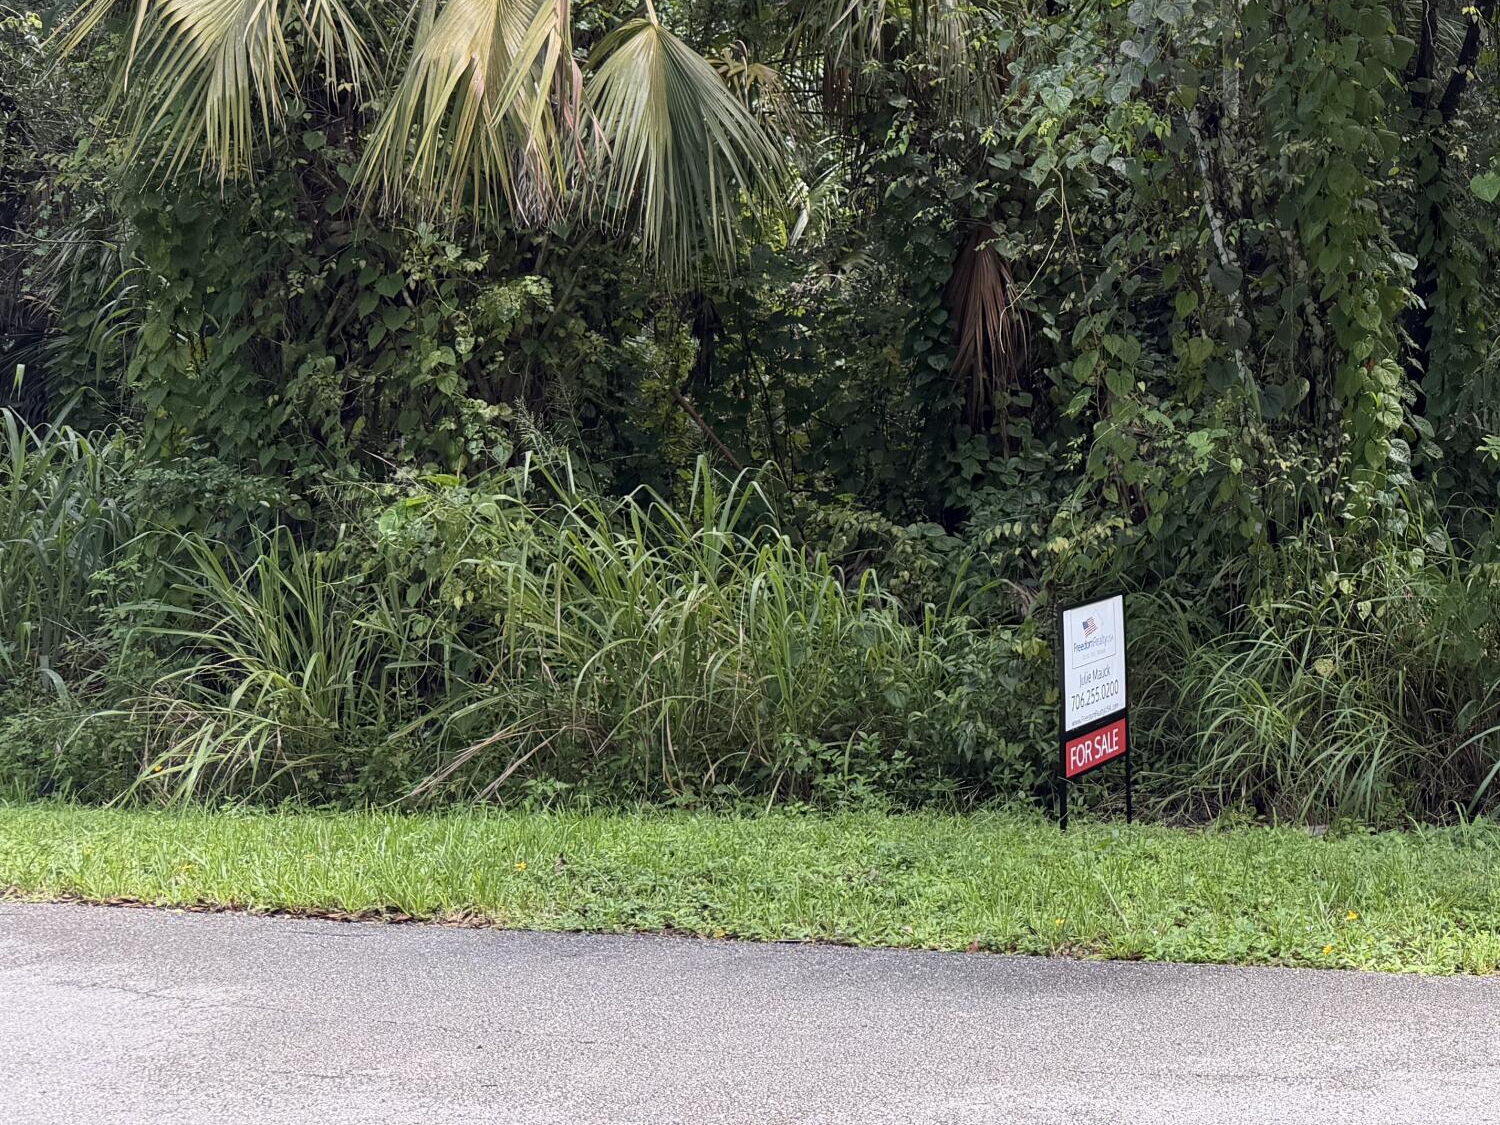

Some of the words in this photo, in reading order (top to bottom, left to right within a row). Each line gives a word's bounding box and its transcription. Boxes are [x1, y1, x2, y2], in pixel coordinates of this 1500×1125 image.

[1071, 679, 1119, 712] 706.255.0200
[1070, 740, 1093, 771] FOR
[1094, 728, 1119, 759] SALE
